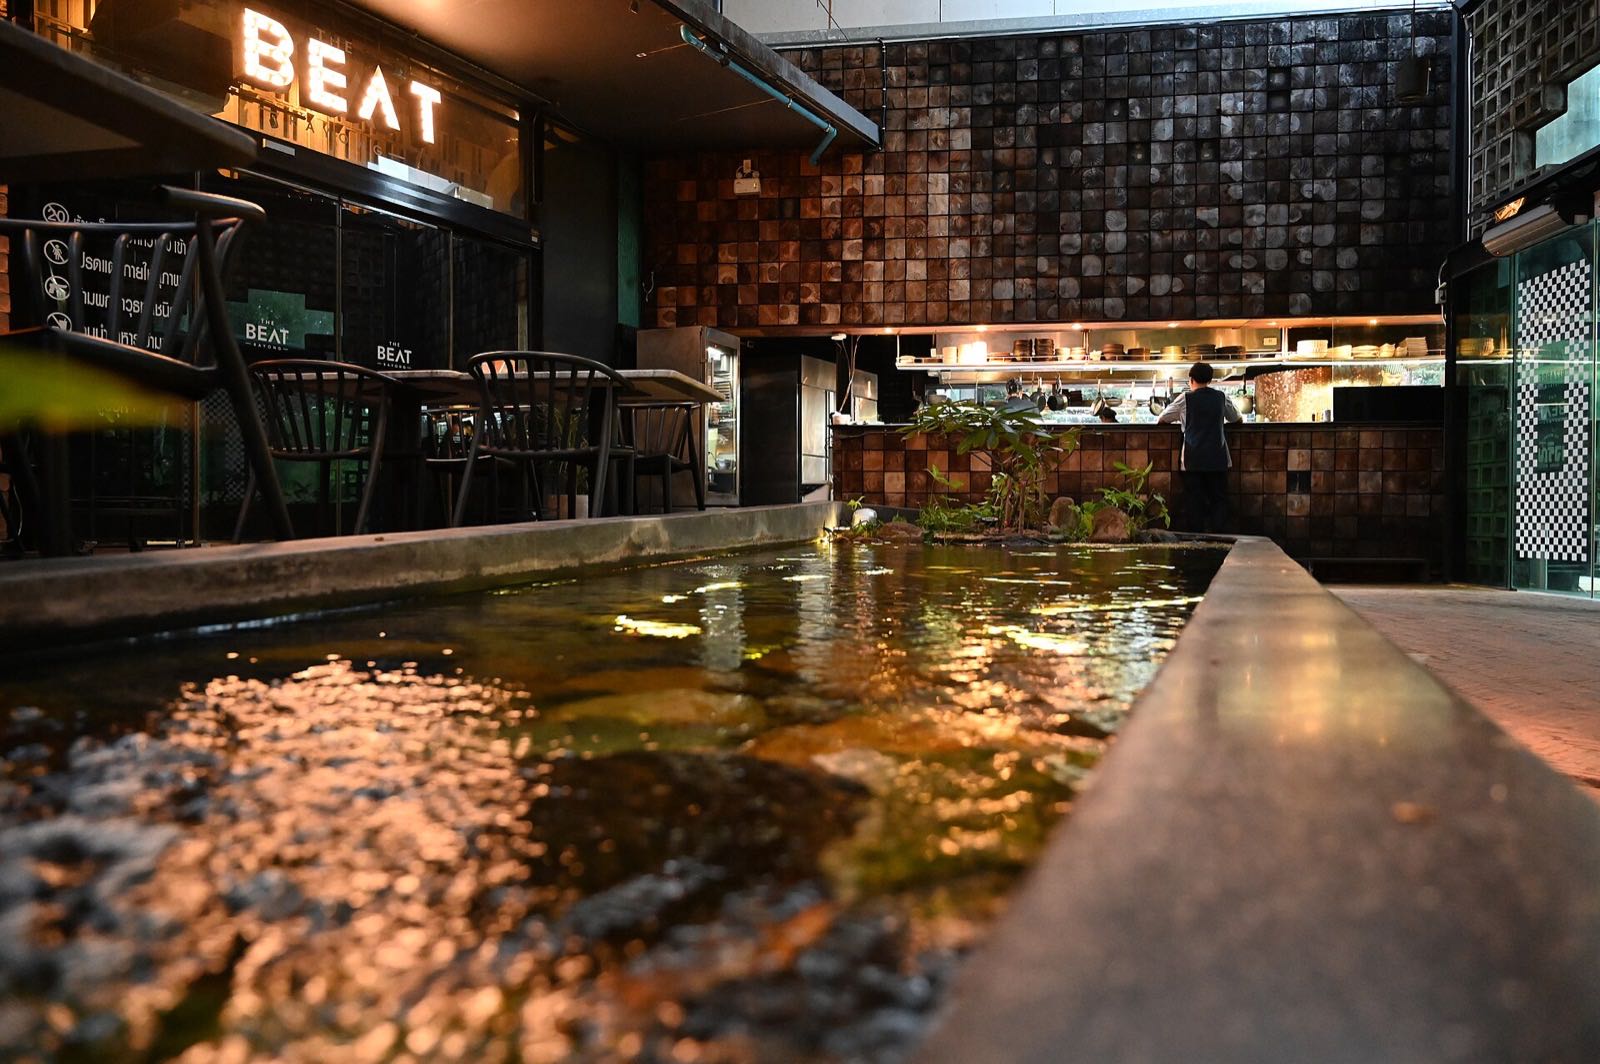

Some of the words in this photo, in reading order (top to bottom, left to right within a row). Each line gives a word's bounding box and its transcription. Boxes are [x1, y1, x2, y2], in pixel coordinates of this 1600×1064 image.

[244, 8, 442, 145] BEAT
[289, 115, 382, 156] RAYOG
[246, 323, 289, 345] BEAT
[377, 345, 412, 364] BEAT
